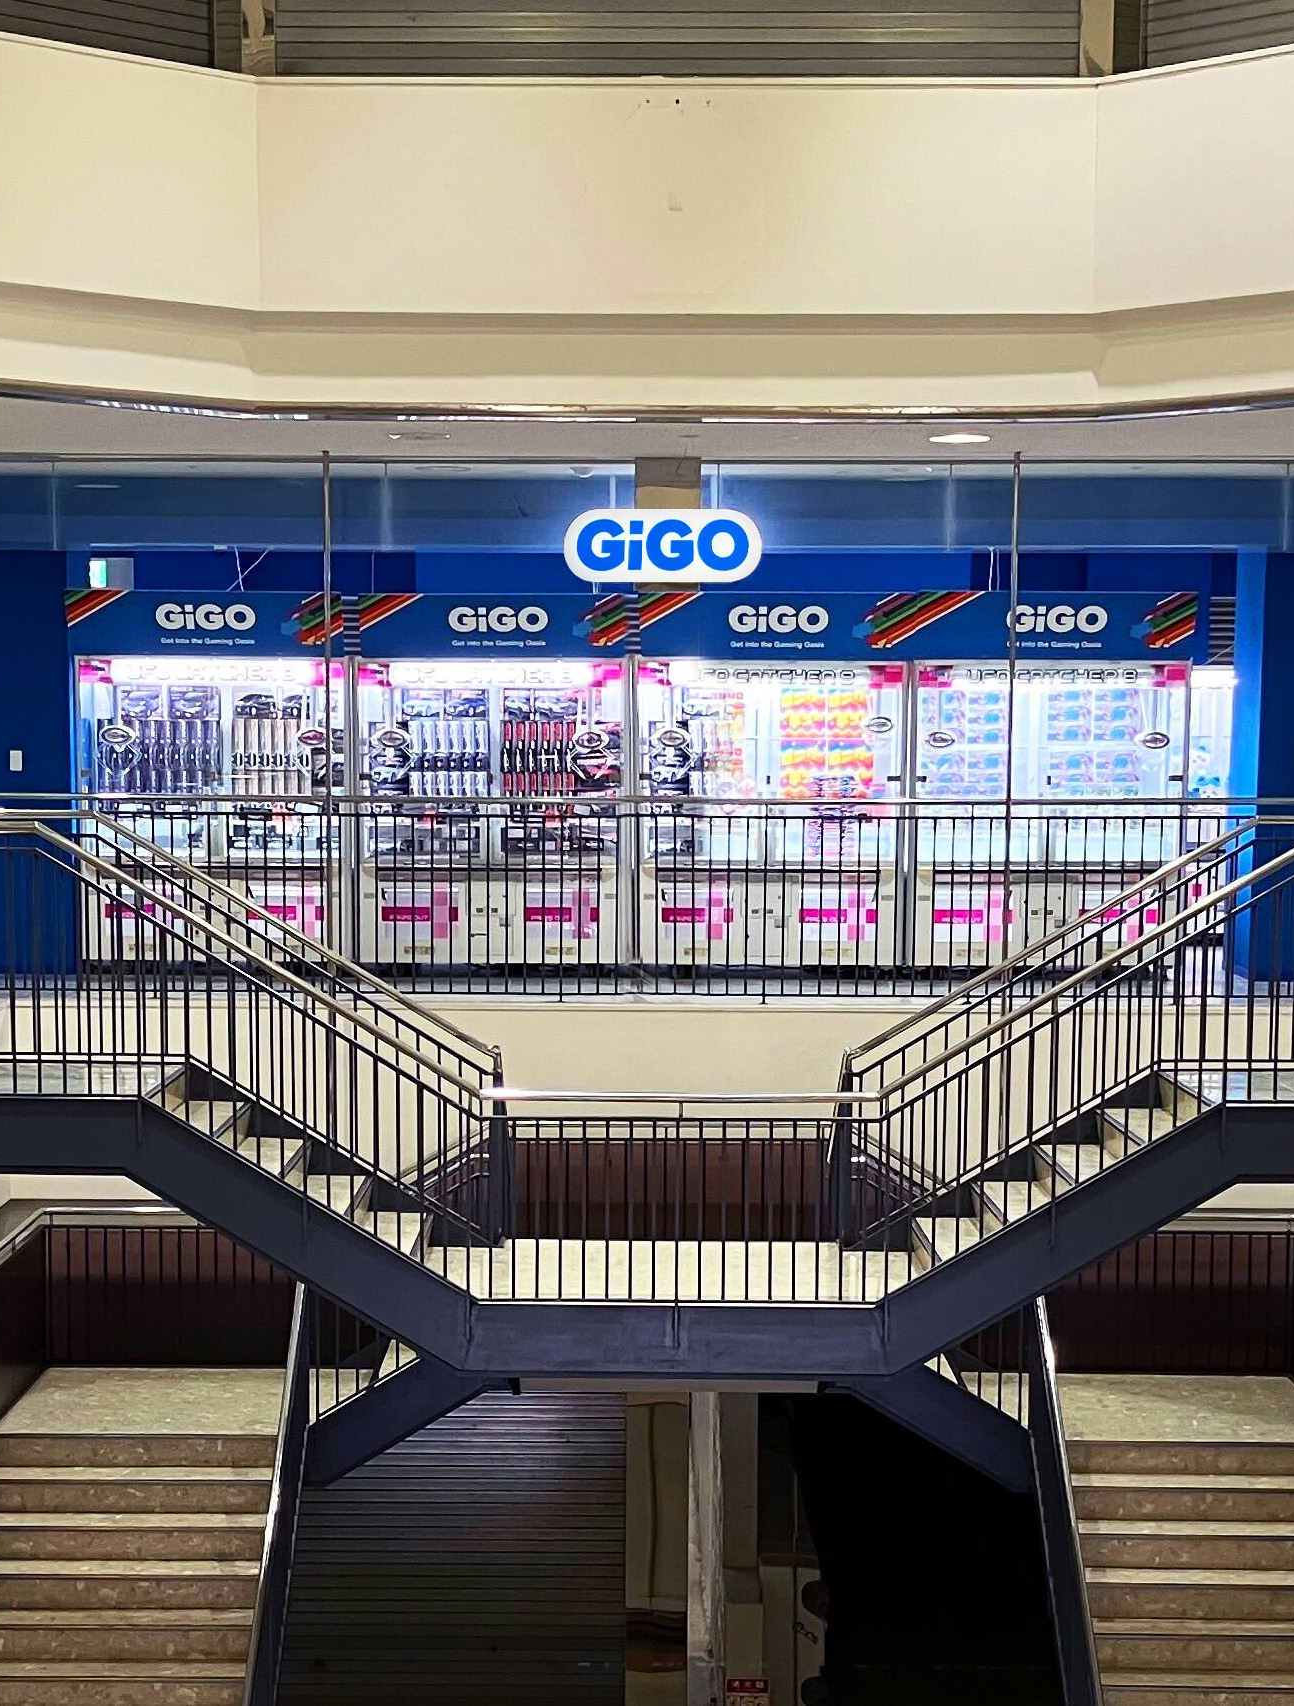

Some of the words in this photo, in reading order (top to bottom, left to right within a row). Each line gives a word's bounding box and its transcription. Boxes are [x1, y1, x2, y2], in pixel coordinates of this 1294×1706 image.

[576, 518, 750, 572] GiGO
[155, 603, 256, 631] GiGO
[448, 606, 549, 633] GiGO
[728, 605, 829, 634] GiGO
[1006, 605, 1108, 634] GiGO
